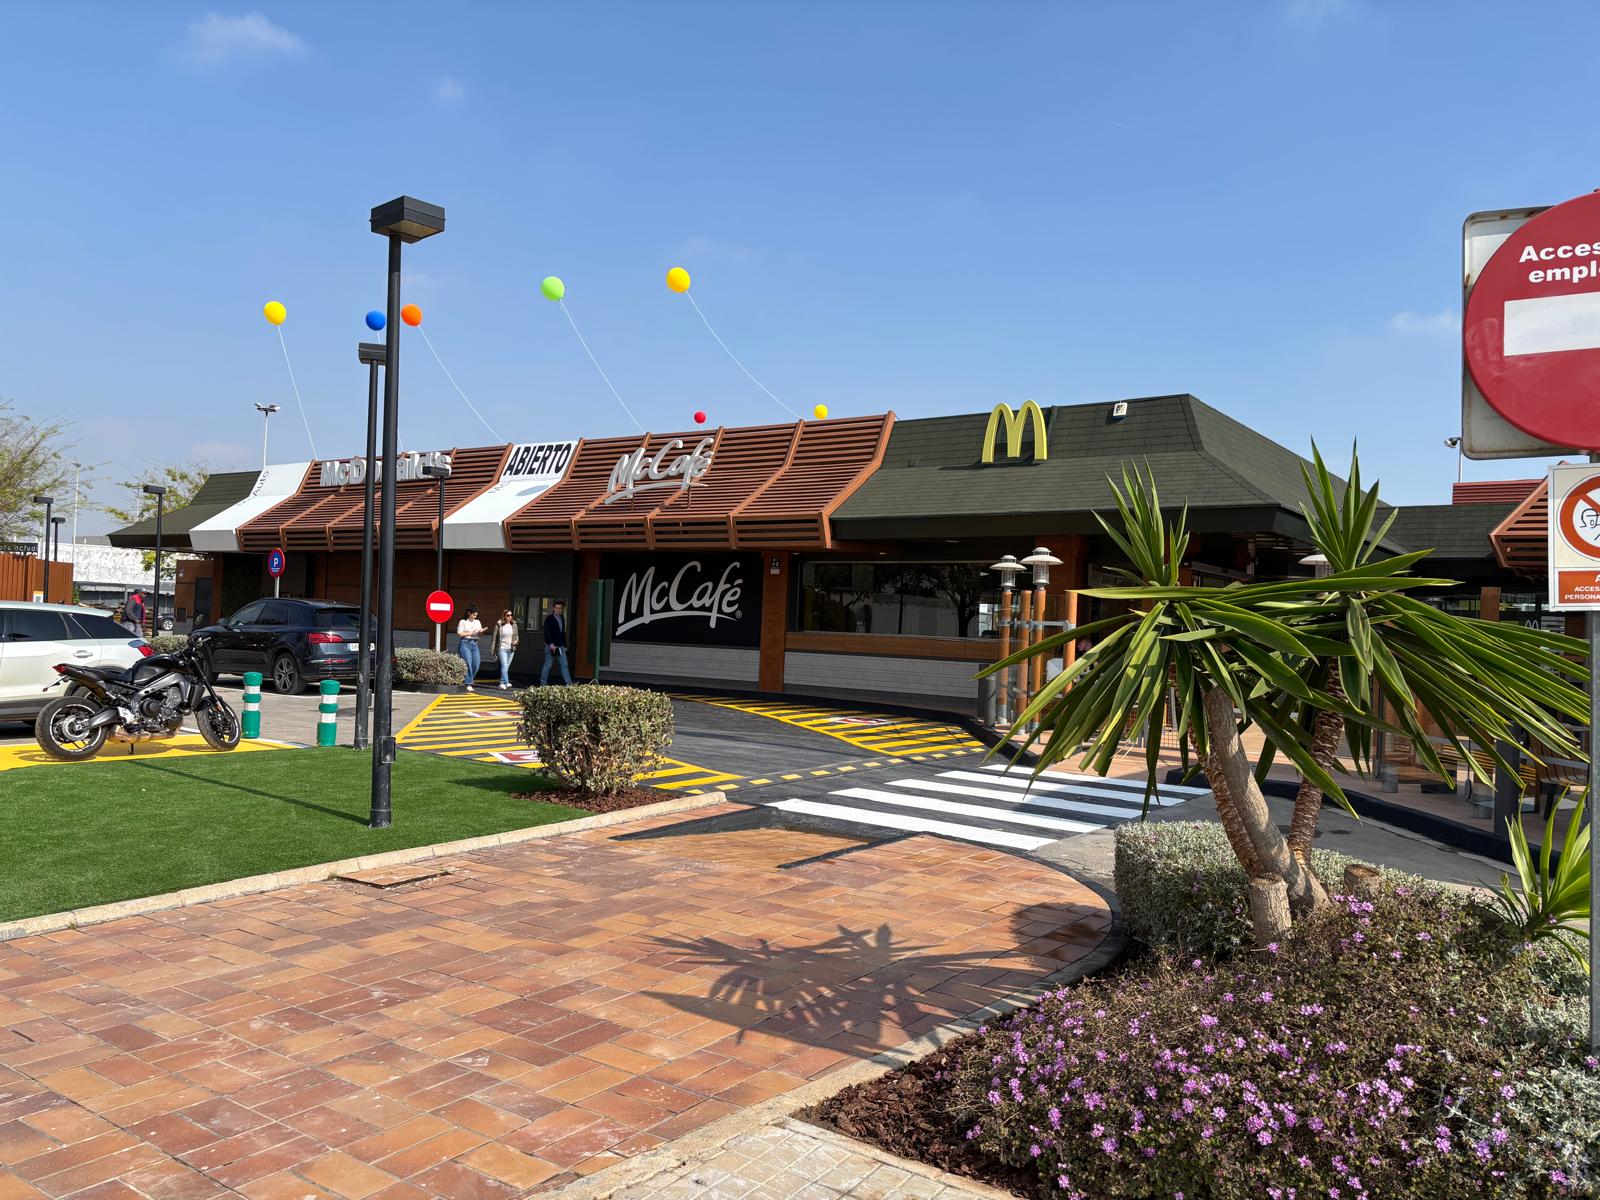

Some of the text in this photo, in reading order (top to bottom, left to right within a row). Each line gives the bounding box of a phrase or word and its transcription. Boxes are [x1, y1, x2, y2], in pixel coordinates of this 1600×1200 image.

[1528, 260, 1600, 283] empl
[319, 451, 451, 487] McDald's
[503, 443, 571, 476] ABIERTO
[273, 557, 279, 568] P
[615, 560, 743, 636] McCafé
